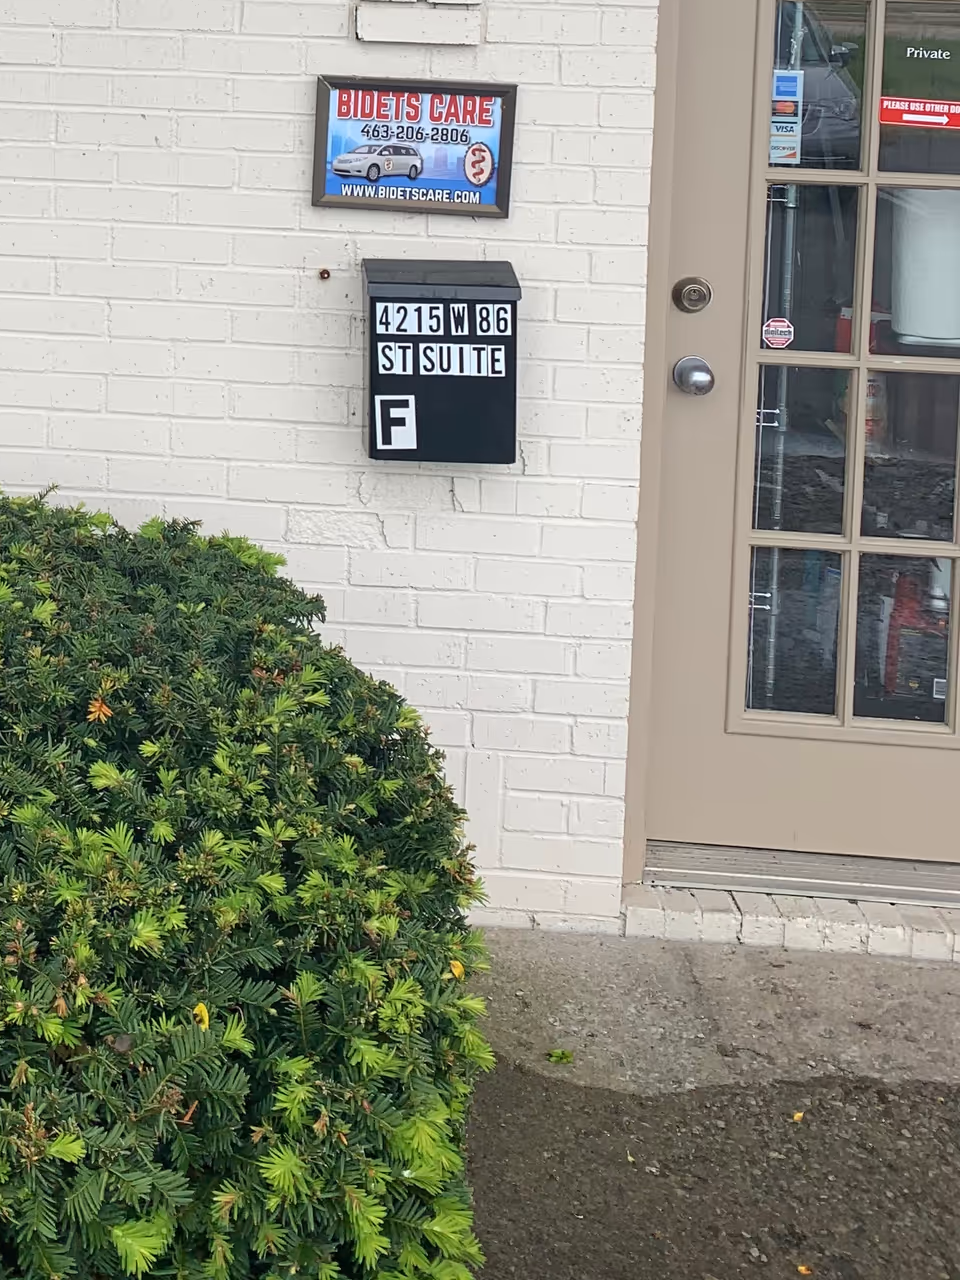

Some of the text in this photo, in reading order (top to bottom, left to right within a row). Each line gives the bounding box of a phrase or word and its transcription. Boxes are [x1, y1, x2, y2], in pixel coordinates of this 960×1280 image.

[906, 47, 951, 59] Private
[337, 88, 494, 126] BIDETS CARE
[883, 100, 909, 110] PLEASE
[910, 102, 925, 111] USE
[925, 103, 949, 113] OTHER
[360, 123, 470, 144] 463-206-2806
[775, 125, 794, 133] VISA
[341, 183, 480, 204] WWW.BIDETSCARE.COM
[378, 304, 509, 333] 4215 W 86
[381, 344, 503, 375] ST SUITE
[379, 399, 410, 446] F
